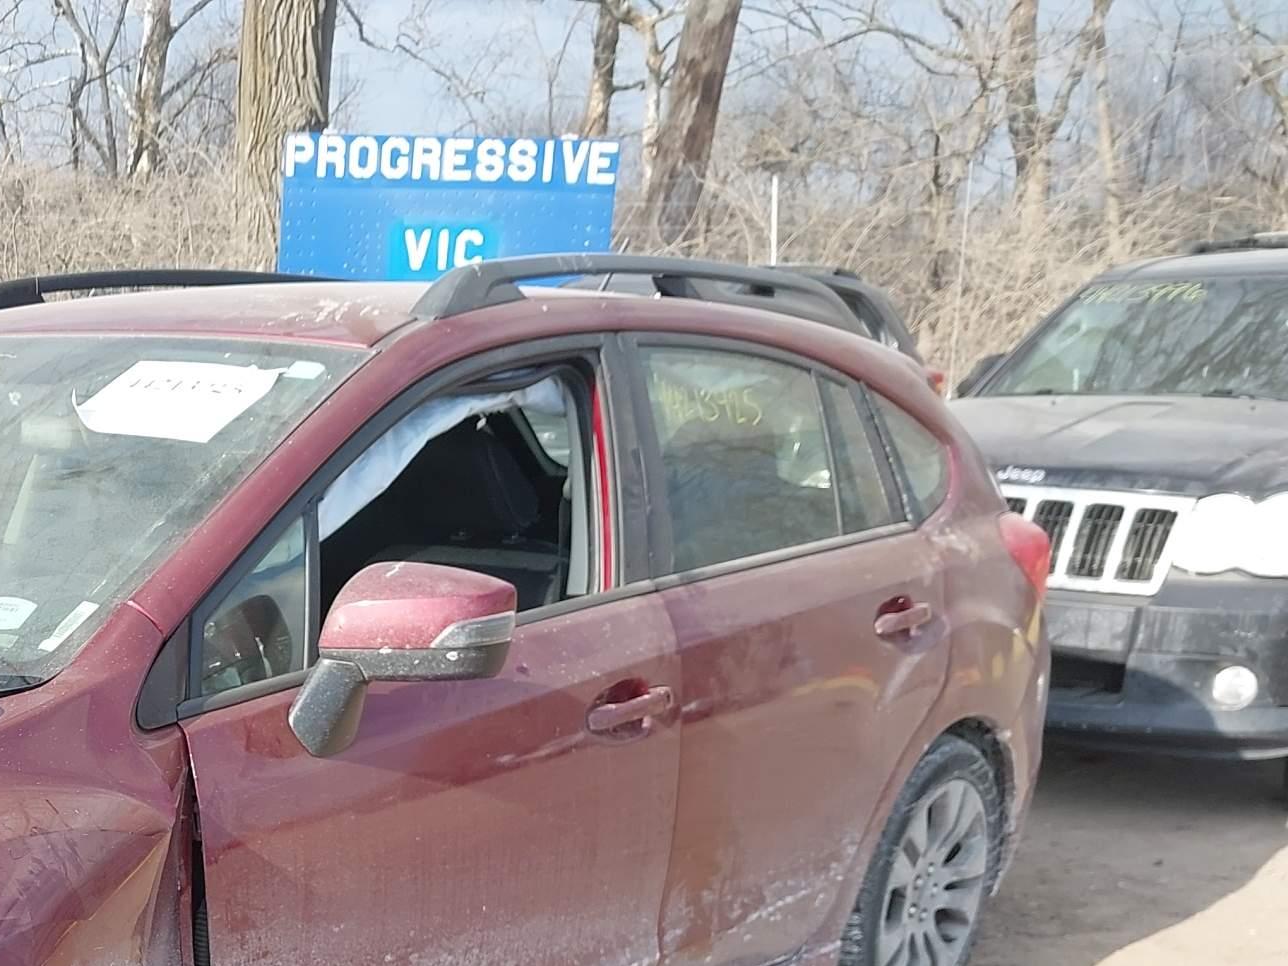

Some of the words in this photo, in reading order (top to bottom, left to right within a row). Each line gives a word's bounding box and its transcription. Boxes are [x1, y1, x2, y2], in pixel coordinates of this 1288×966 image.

[285, 135, 619, 186] PROGRESSIVE
[404, 228, 485, 271] VIC
[996, 464, 1046, 483] Jeep
